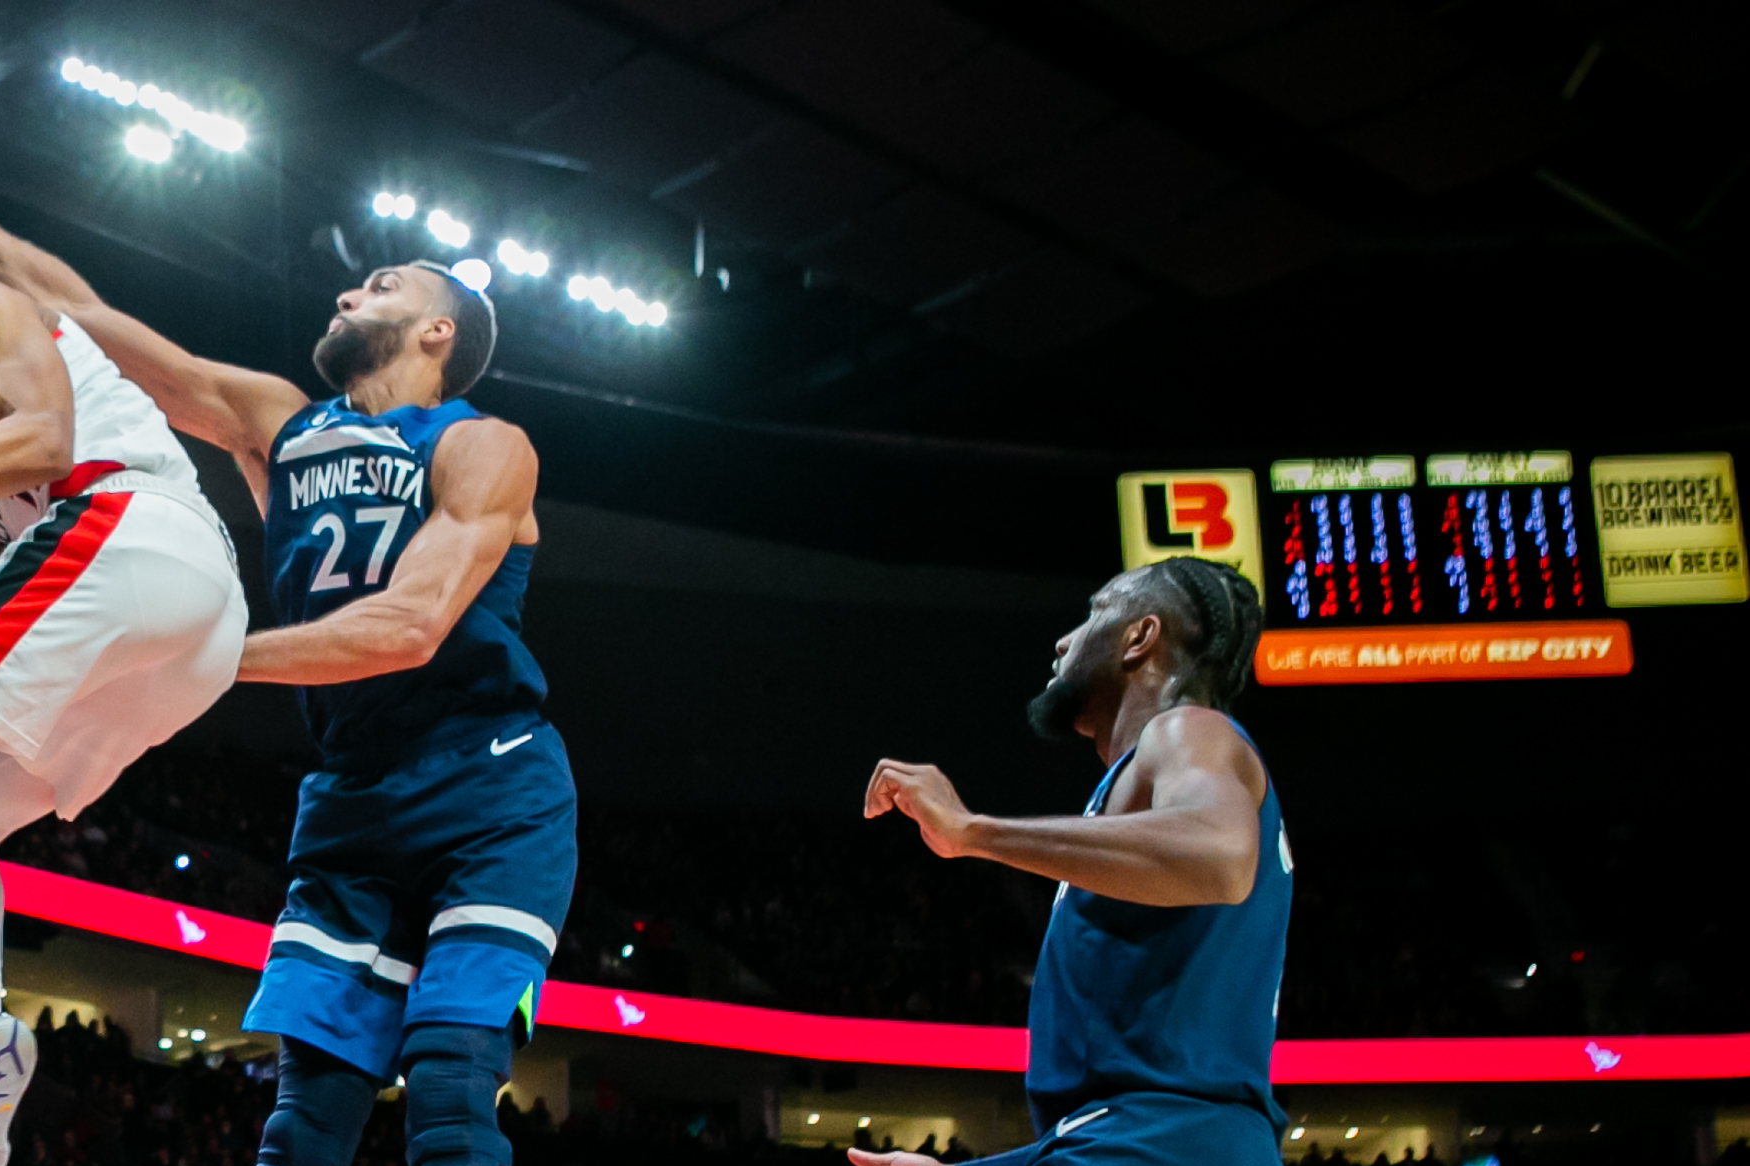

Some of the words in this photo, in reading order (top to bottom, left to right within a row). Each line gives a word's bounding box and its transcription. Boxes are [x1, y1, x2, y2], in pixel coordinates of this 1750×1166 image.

[289, 455, 425, 511] MINNESOTA
[309, 504, 406, 592] 27
[1605, 553, 1673, 578] DRINK
[1680, 550, 1739, 575] BEER
[1267, 648, 1306, 671] WE
[1309, 645, 1354, 668] ARE
[1357, 643, 1403, 668] ALL
[1405, 641, 1458, 665] PART
[1486, 638, 1541, 664] RIP
[1542, 636, 1613, 662] CITY
